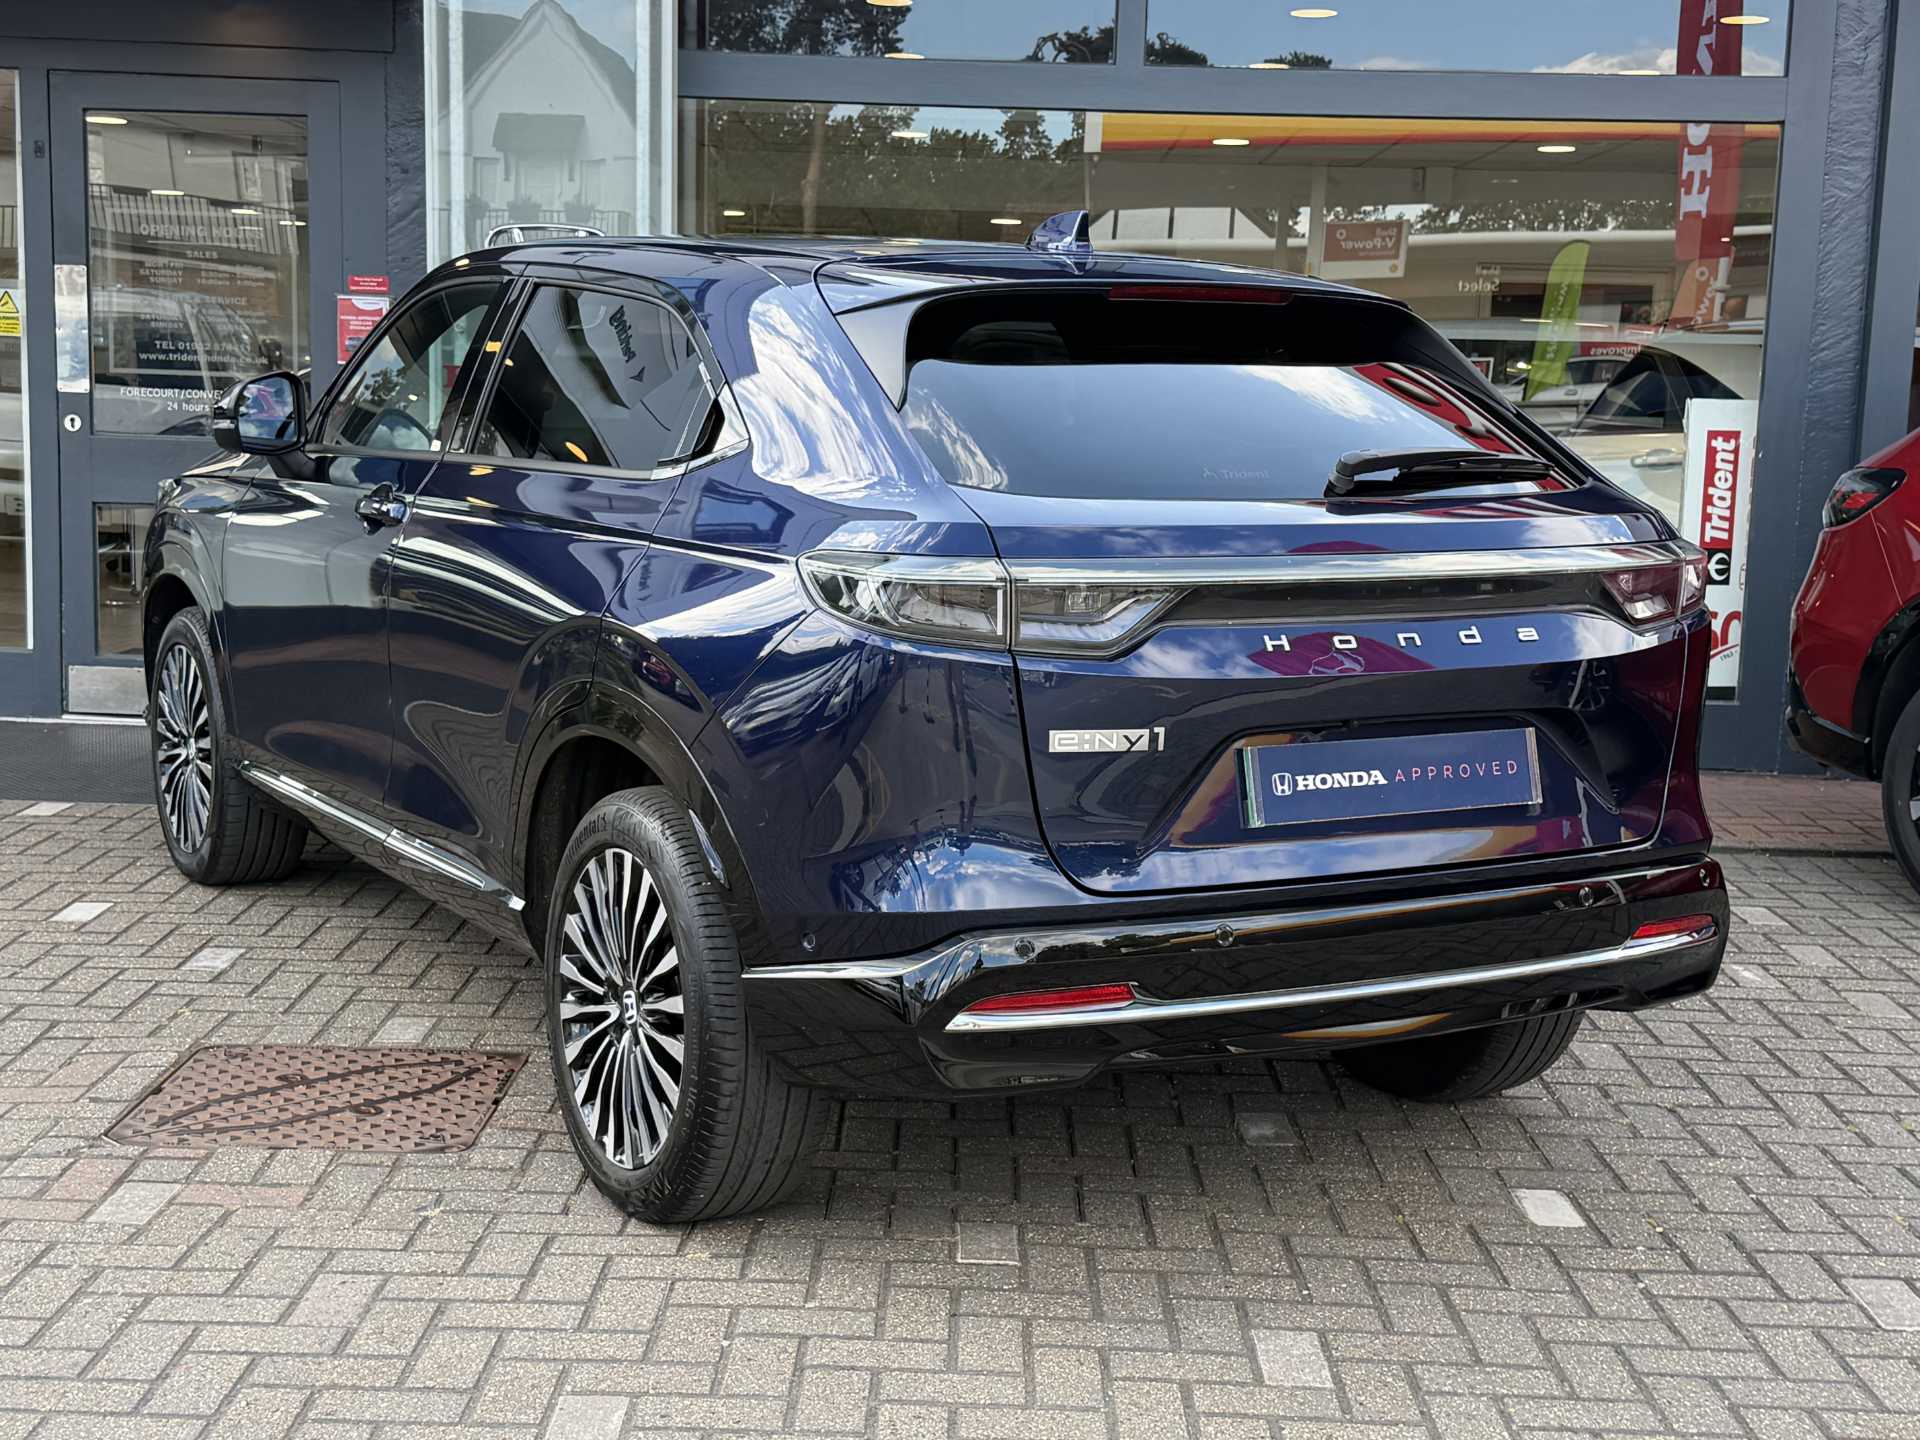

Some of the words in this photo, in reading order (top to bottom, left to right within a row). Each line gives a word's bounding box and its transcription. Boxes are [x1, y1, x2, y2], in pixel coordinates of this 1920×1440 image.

[185, 250, 218, 260] SALES
[154, 340, 175, 350] TEL
[120, 387, 224, 400] FORECOURT/CONVE
[167, 401, 178, 411] 24
[182, 402, 210, 412] hours
[1704, 436, 1737, 544] Trident
[1296, 769, 1388, 792] HONDA
[1395, 760, 1518, 784] APPROVED
